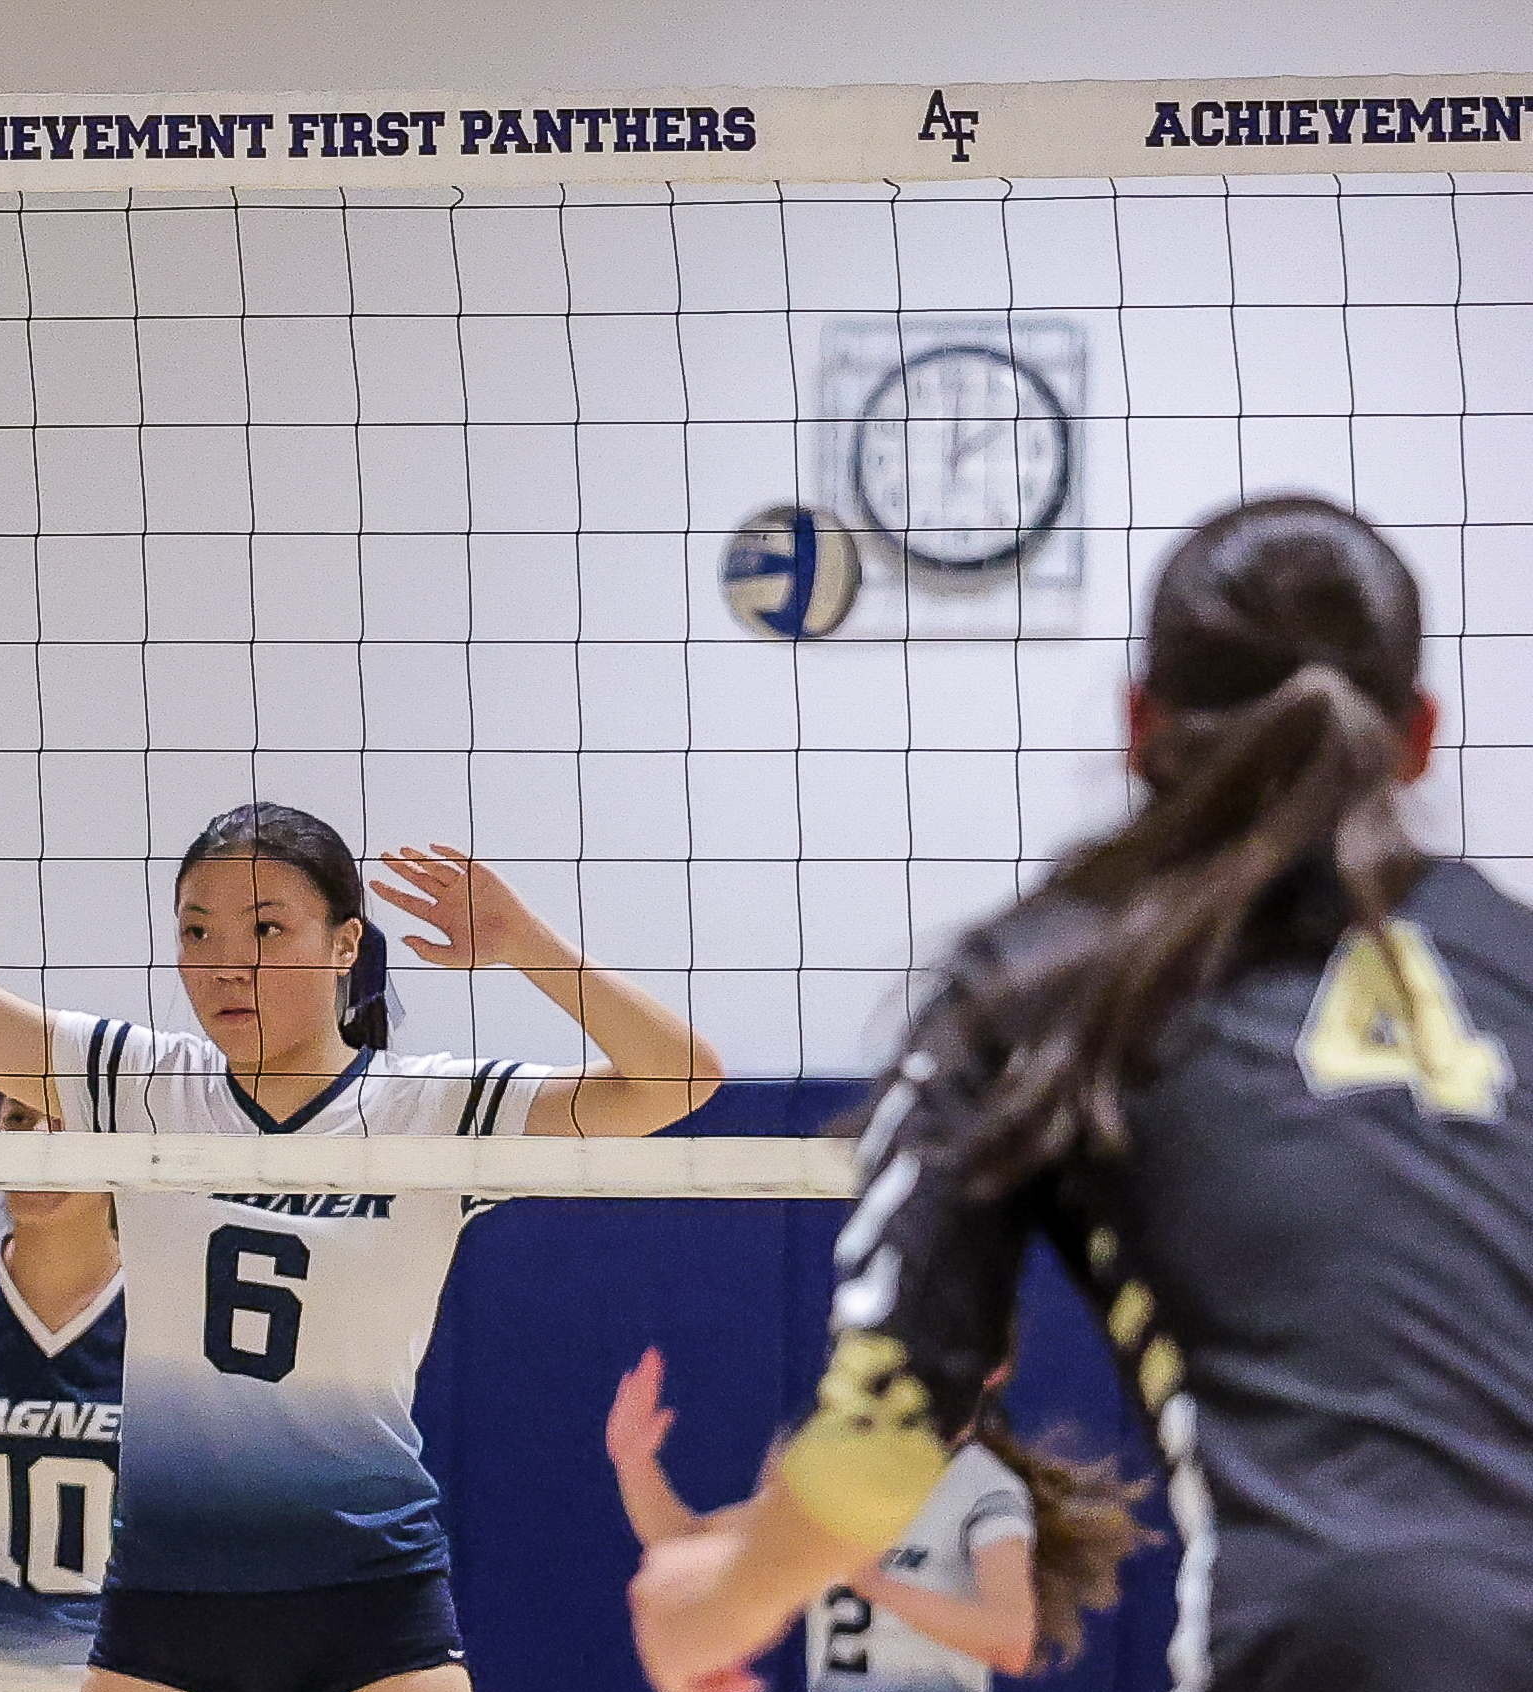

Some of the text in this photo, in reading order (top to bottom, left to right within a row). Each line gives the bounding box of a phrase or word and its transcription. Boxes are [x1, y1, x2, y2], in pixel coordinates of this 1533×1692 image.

[288, 111, 445, 158] FIRST
[460, 107, 756, 154] PANTHERS
[918, 89, 979, 162] AF
[1145, 96, 1533, 147] ACHIEVEMEN
[1294, 918, 1515, 1122] 4
[208, 1193, 396, 1218] NER
[204, 1224, 310, 1383] 6
